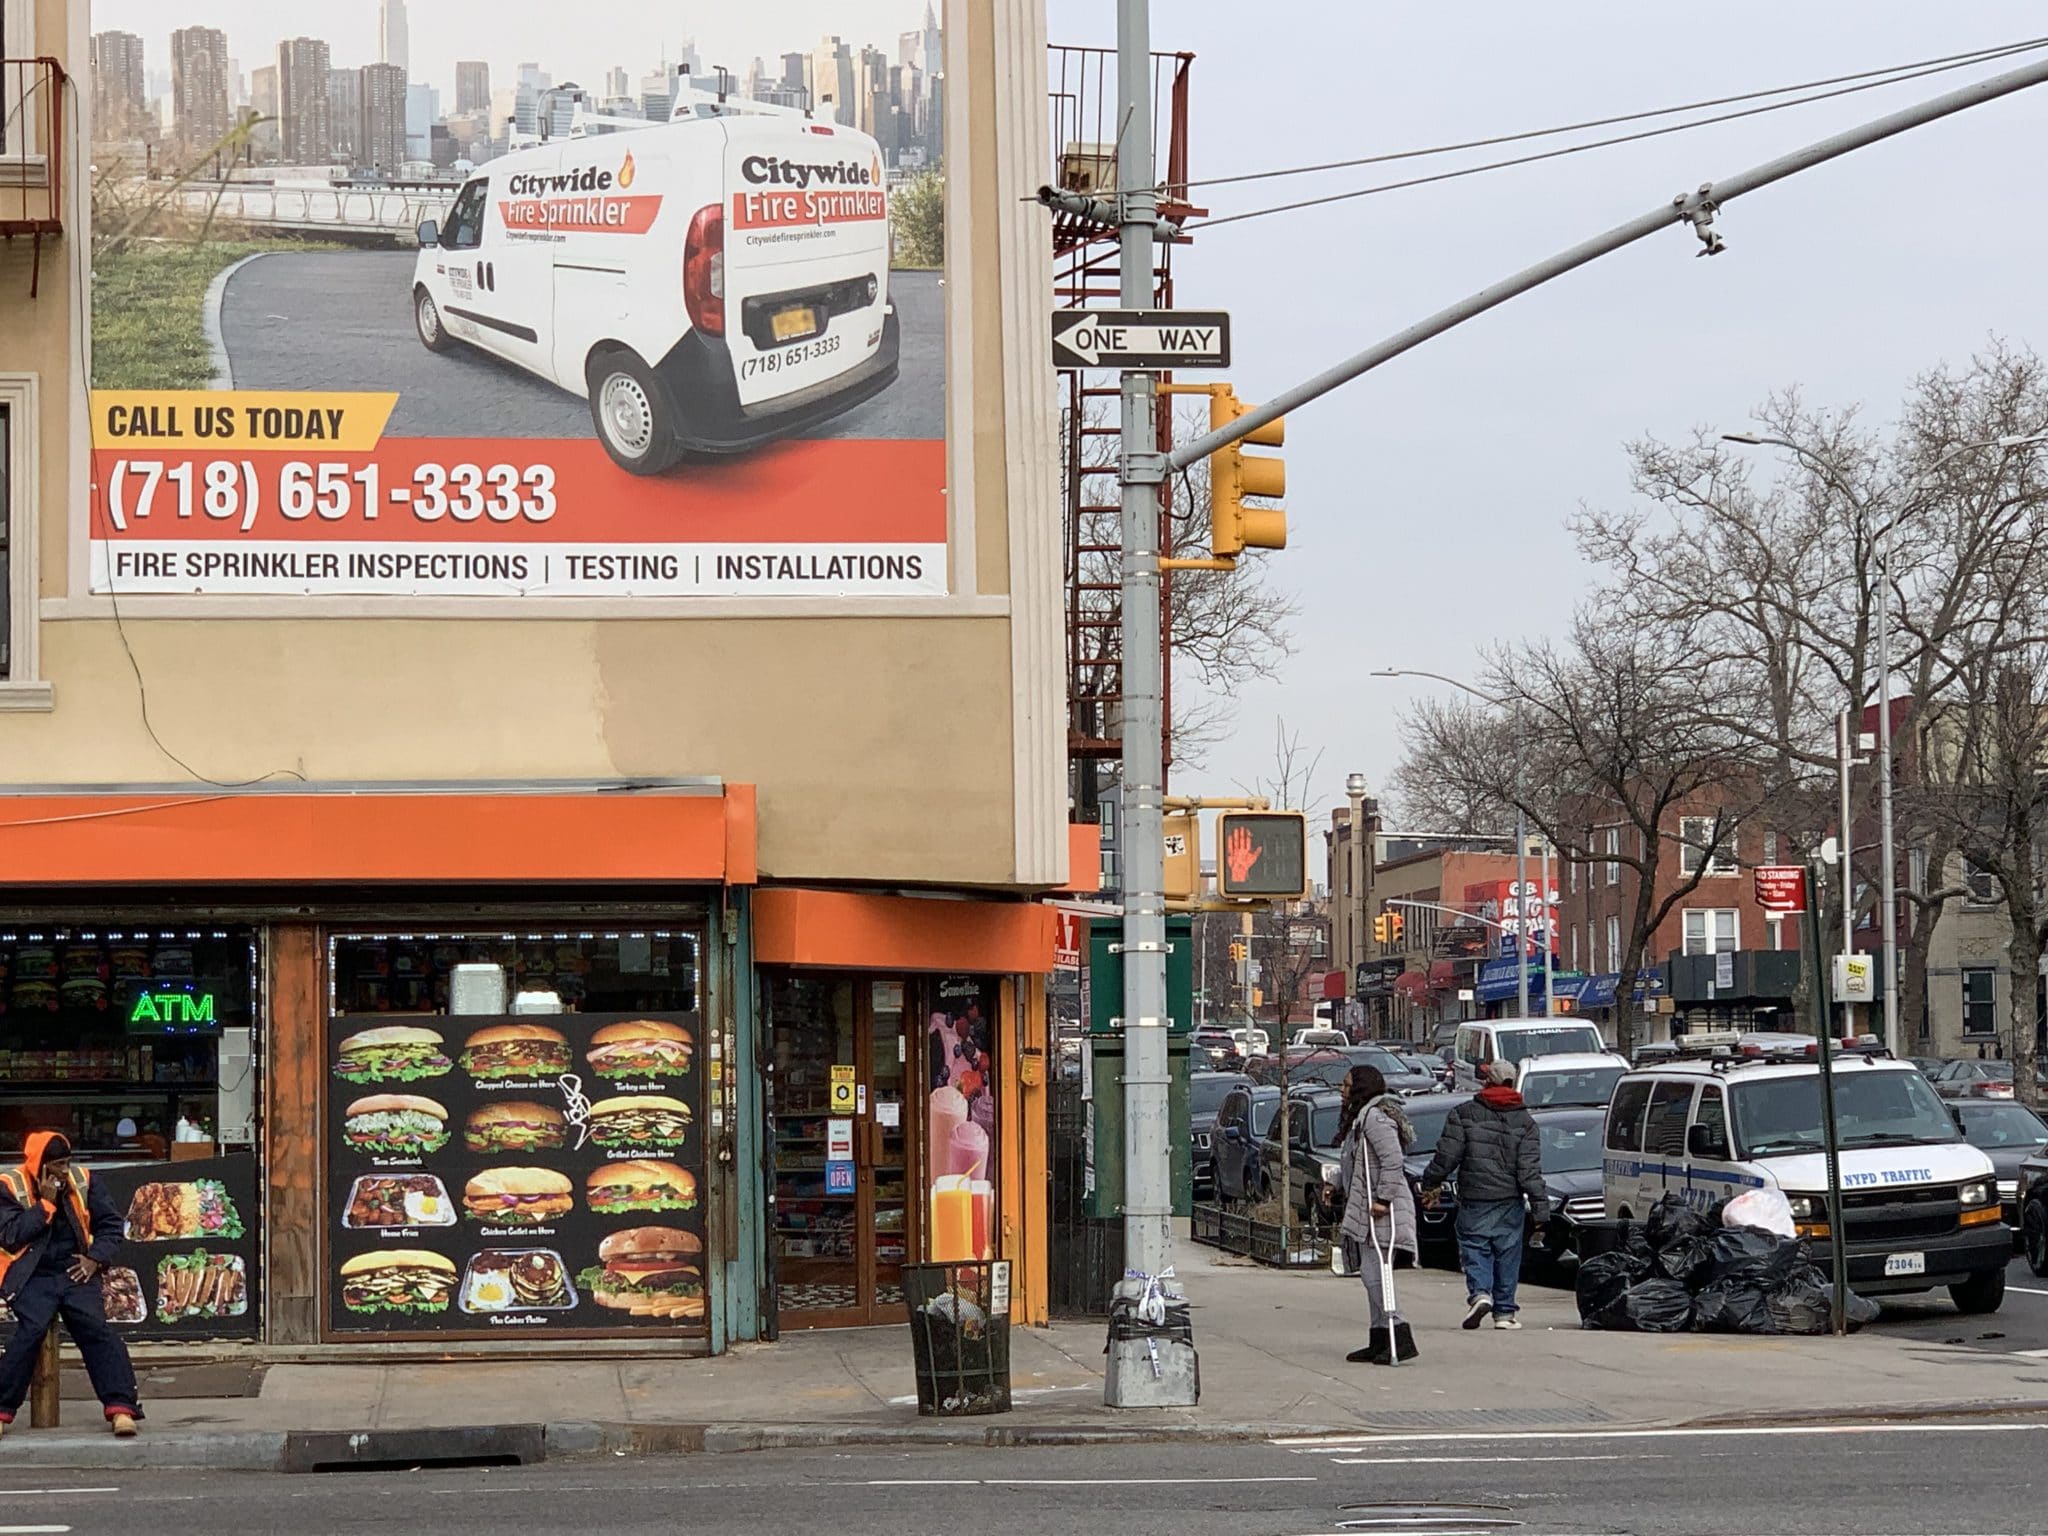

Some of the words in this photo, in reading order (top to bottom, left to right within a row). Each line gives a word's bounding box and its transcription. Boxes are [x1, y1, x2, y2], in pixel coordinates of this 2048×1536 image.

[509, 166, 612, 198] Citywide
[742, 155, 869, 189] Citywide
[507, 201, 535, 223] Fire
[539, 197, 631, 230] Sprinkler
[745, 191, 797, 222] Fire
[805, 190, 882, 226] Sprinkler
[746, 230, 836, 246] Citywidefiresprinkler.com
[1076, 329, 1127, 350] ONE
[1159, 329, 1214, 351] WAY
[742, 353, 781, 380] (718)
[786, 335, 840, 366] 651-3333
[107, 405, 183, 438] CALL
[194, 407, 235, 438] US
[246, 408, 344, 440] TODAY
[108, 460, 259, 532] (718)
[278, 461, 557, 522] 651-3333
[116, 552, 177, 578] FIRE
[185, 553, 339, 579] SPRINKLER
[348, 554, 529, 580] INSPECTIONS
[565, 555, 678, 580] TESTING
[716, 555, 922, 580] INSTALLATIONS
[1767, 870, 1799, 880] STANDING
[939, 980, 980, 998] Smoothie
[131, 994, 214, 1021] ATM
[538, 1080, 556, 1089] Hero
[648, 1082, 665, 1091] Hero
[389, 1156, 423, 1166] Sandwich
[830, 1171, 852, 1187] OPEN
[1844, 1173, 1877, 1186] NYPD
[1880, 1169, 1932, 1183] TRAFFIC
[480, 1227, 507, 1237] Chicken
[1888, 1259, 1913, 1269] 7304
